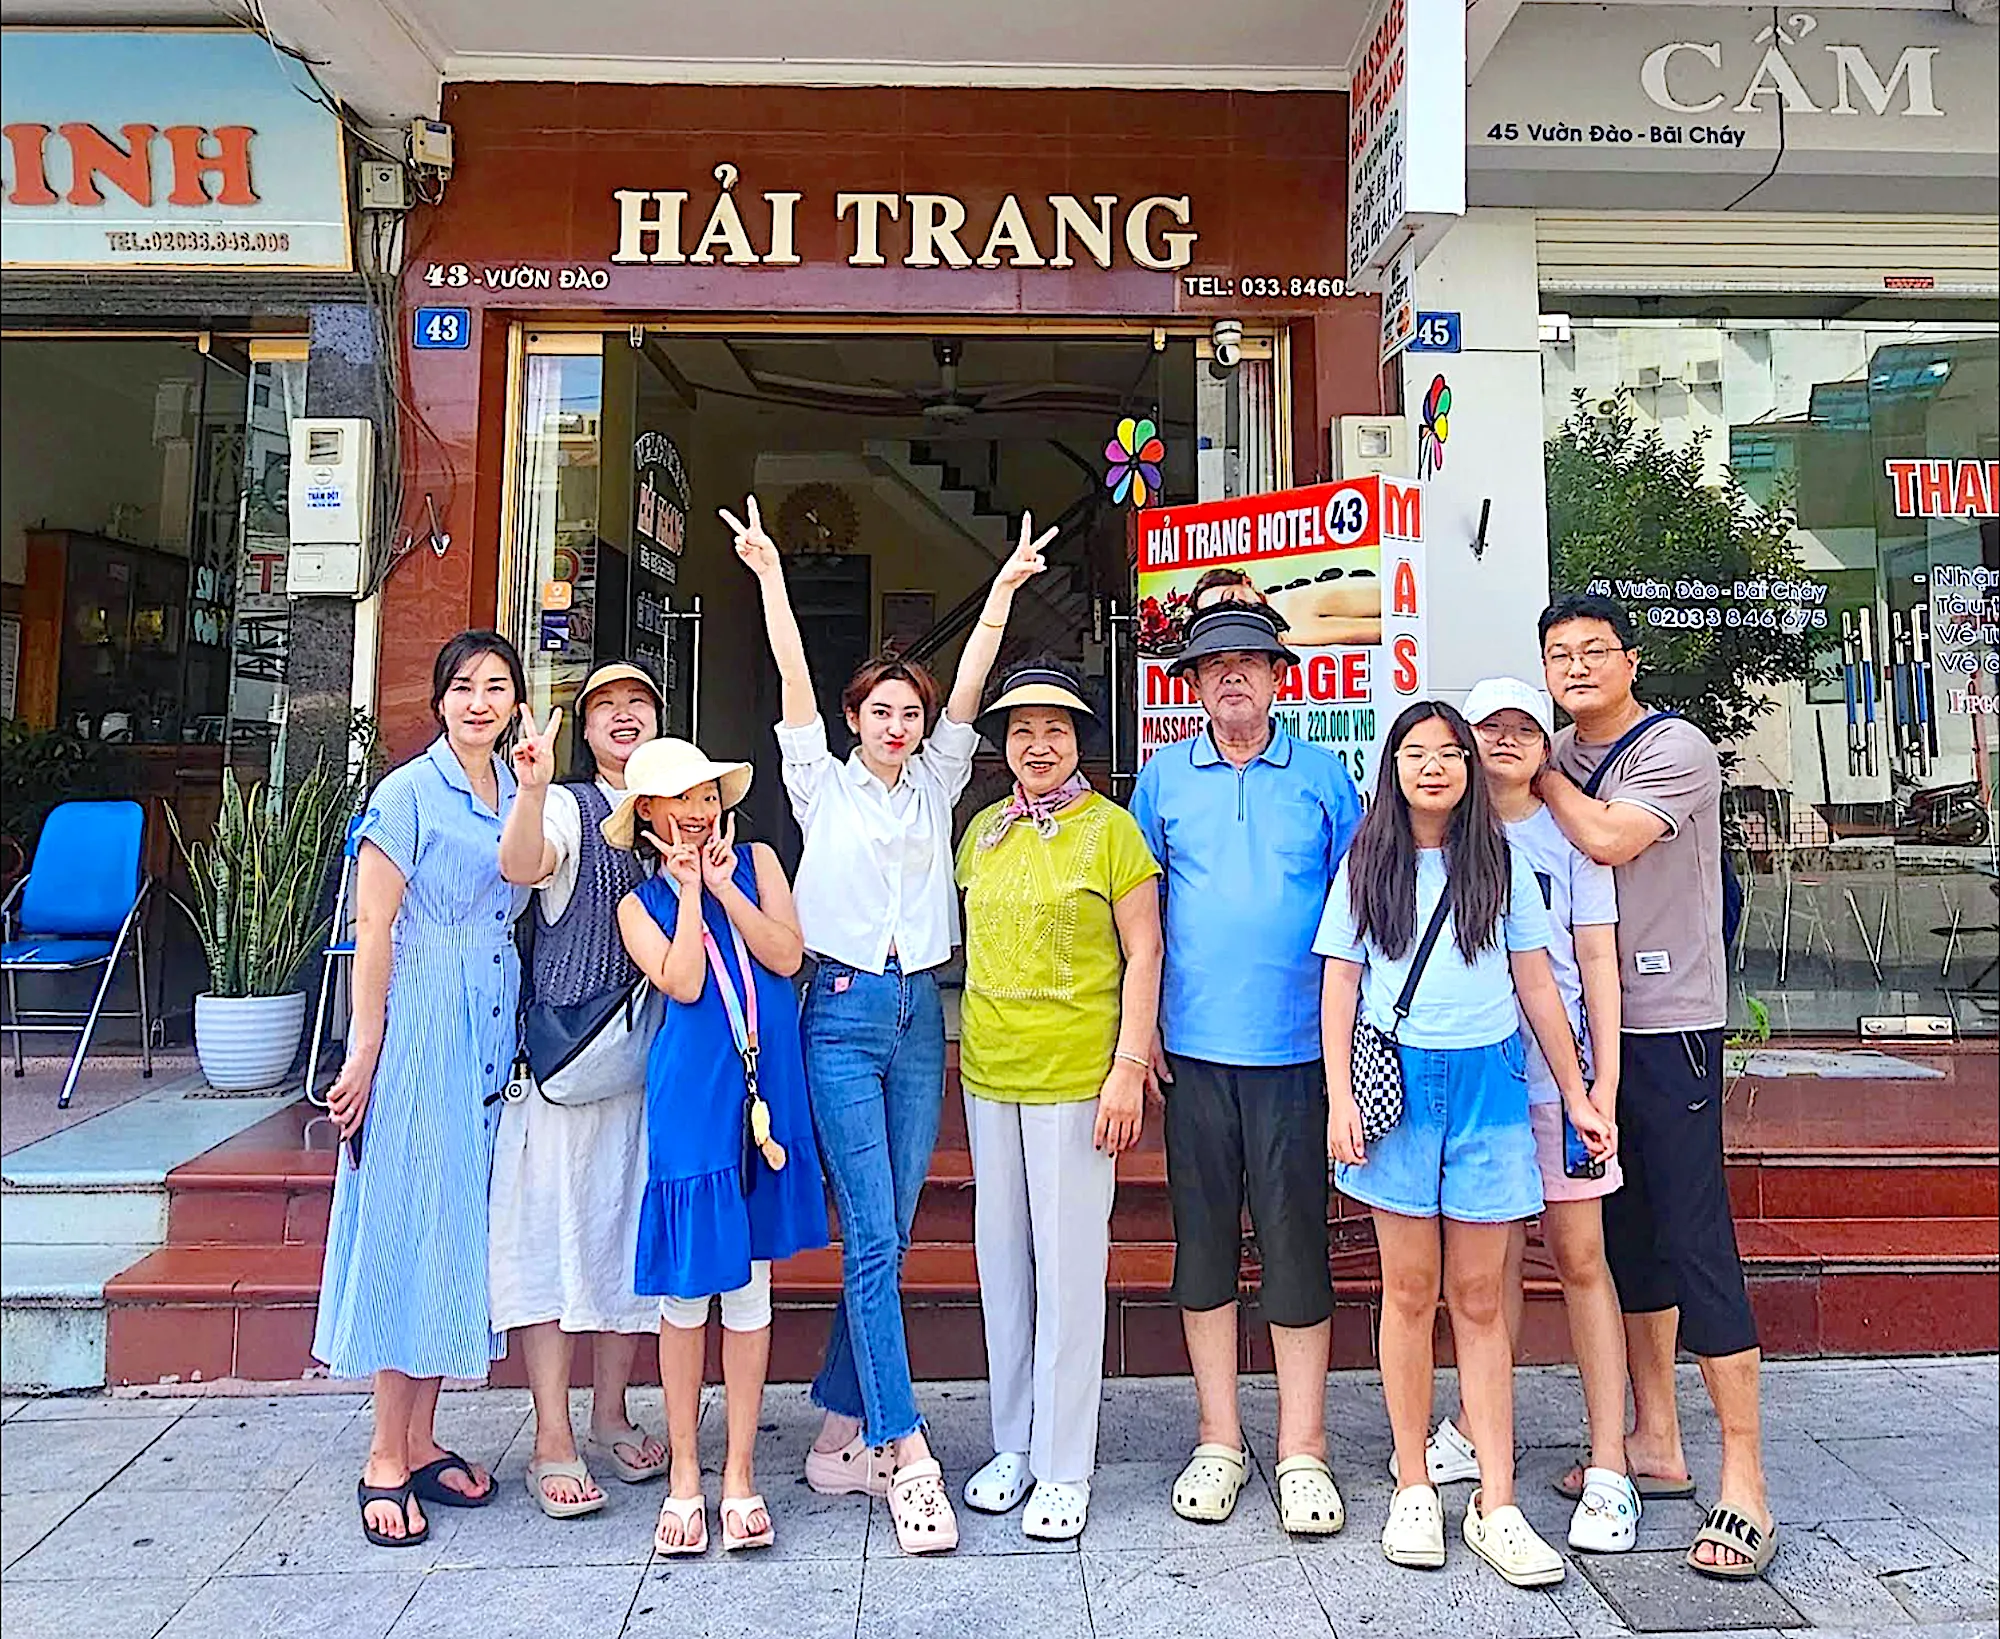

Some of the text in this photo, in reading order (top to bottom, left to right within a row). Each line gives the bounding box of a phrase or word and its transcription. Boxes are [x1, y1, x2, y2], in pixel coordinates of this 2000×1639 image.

[1641, 14, 1946, 116] CẨM
[1369, 46, 1404, 132] TRANG
[1487, 123, 1519, 141] 45
[1527, 123, 1583, 142] Vườn
[1589, 123, 1633, 143] Đào
[1650, 125, 1683, 143] Bãi
[1688, 124, 1746, 148] Cháy
[611, 163, 1198, 271] HẢI TRANG
[558, 266, 609, 289] ĐÀO
[1184, 277, 1371, 297] TEL: 033.8460
[425, 314, 459, 341] 43
[1418, 318, 1450, 346] 45
[1147, 497, 1363, 565] HẢI TRANG HOTEL 43
[1771, 580, 1828, 603] Cháy
[1144, 652, 1372, 707] MAGE
[1307, 709, 1350, 742] 220.000
[1352, 708, 1375, 742] VNĐ
